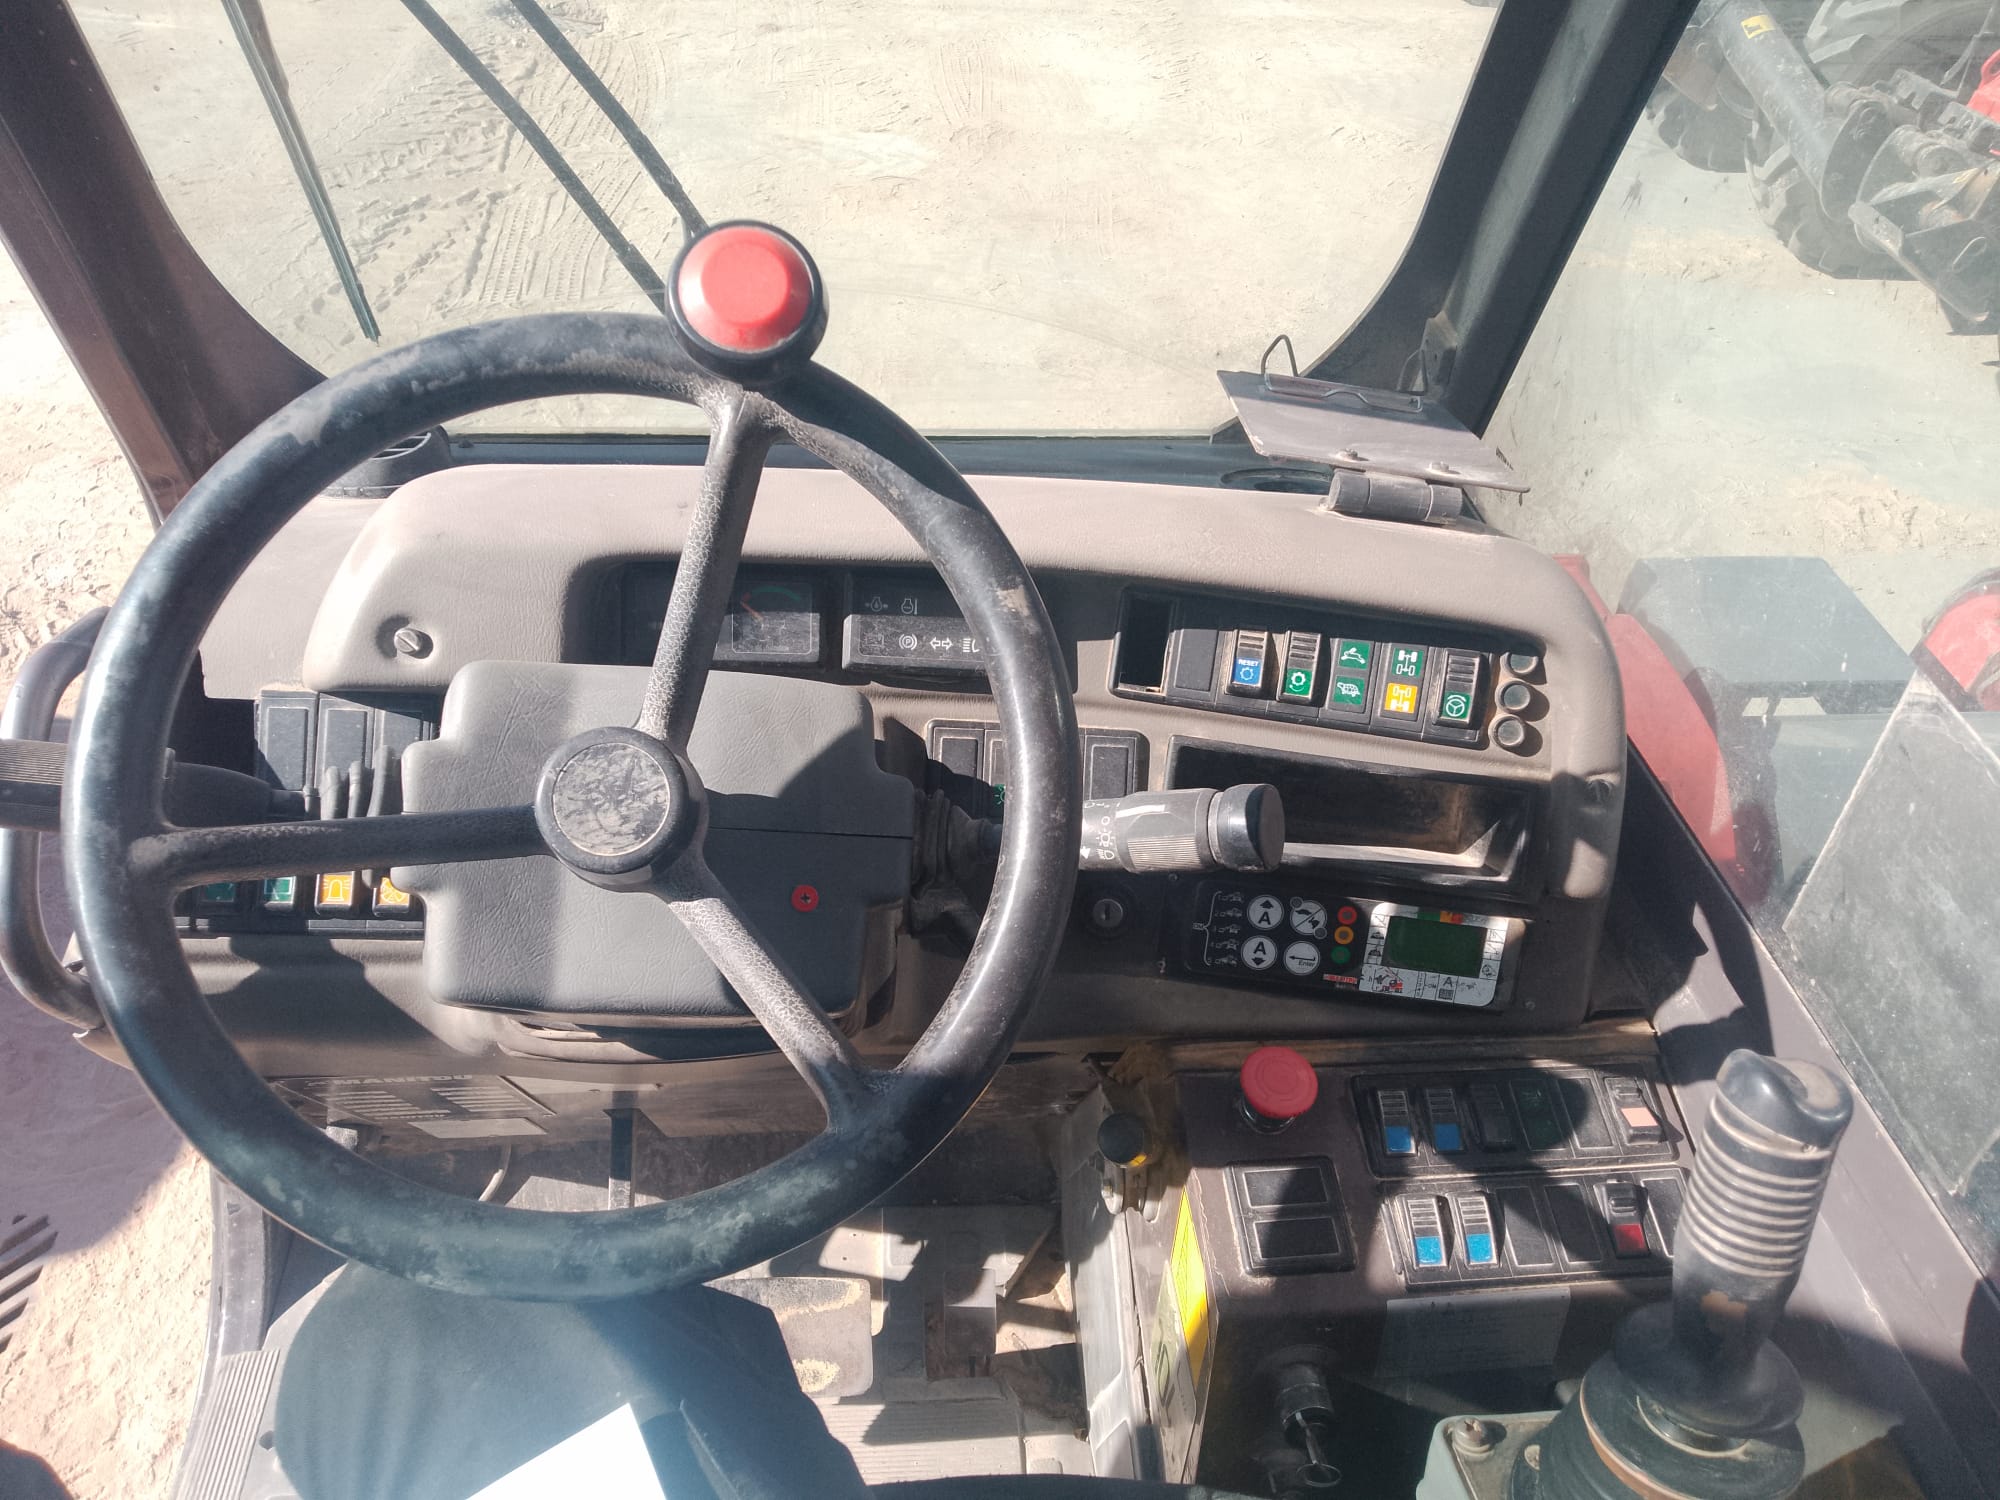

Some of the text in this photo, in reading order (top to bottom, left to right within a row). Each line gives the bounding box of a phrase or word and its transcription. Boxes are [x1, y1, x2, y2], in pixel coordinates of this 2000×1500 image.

[1239, 659, 1259, 667] RESET
[1258, 911, 1271, 925] A
[1253, 941, 1266, 955] A
[1297, 960, 1315, 968] Enter
[1443, 976, 1453, 987] A
[333, 1074, 473, 1085] MANITOU
